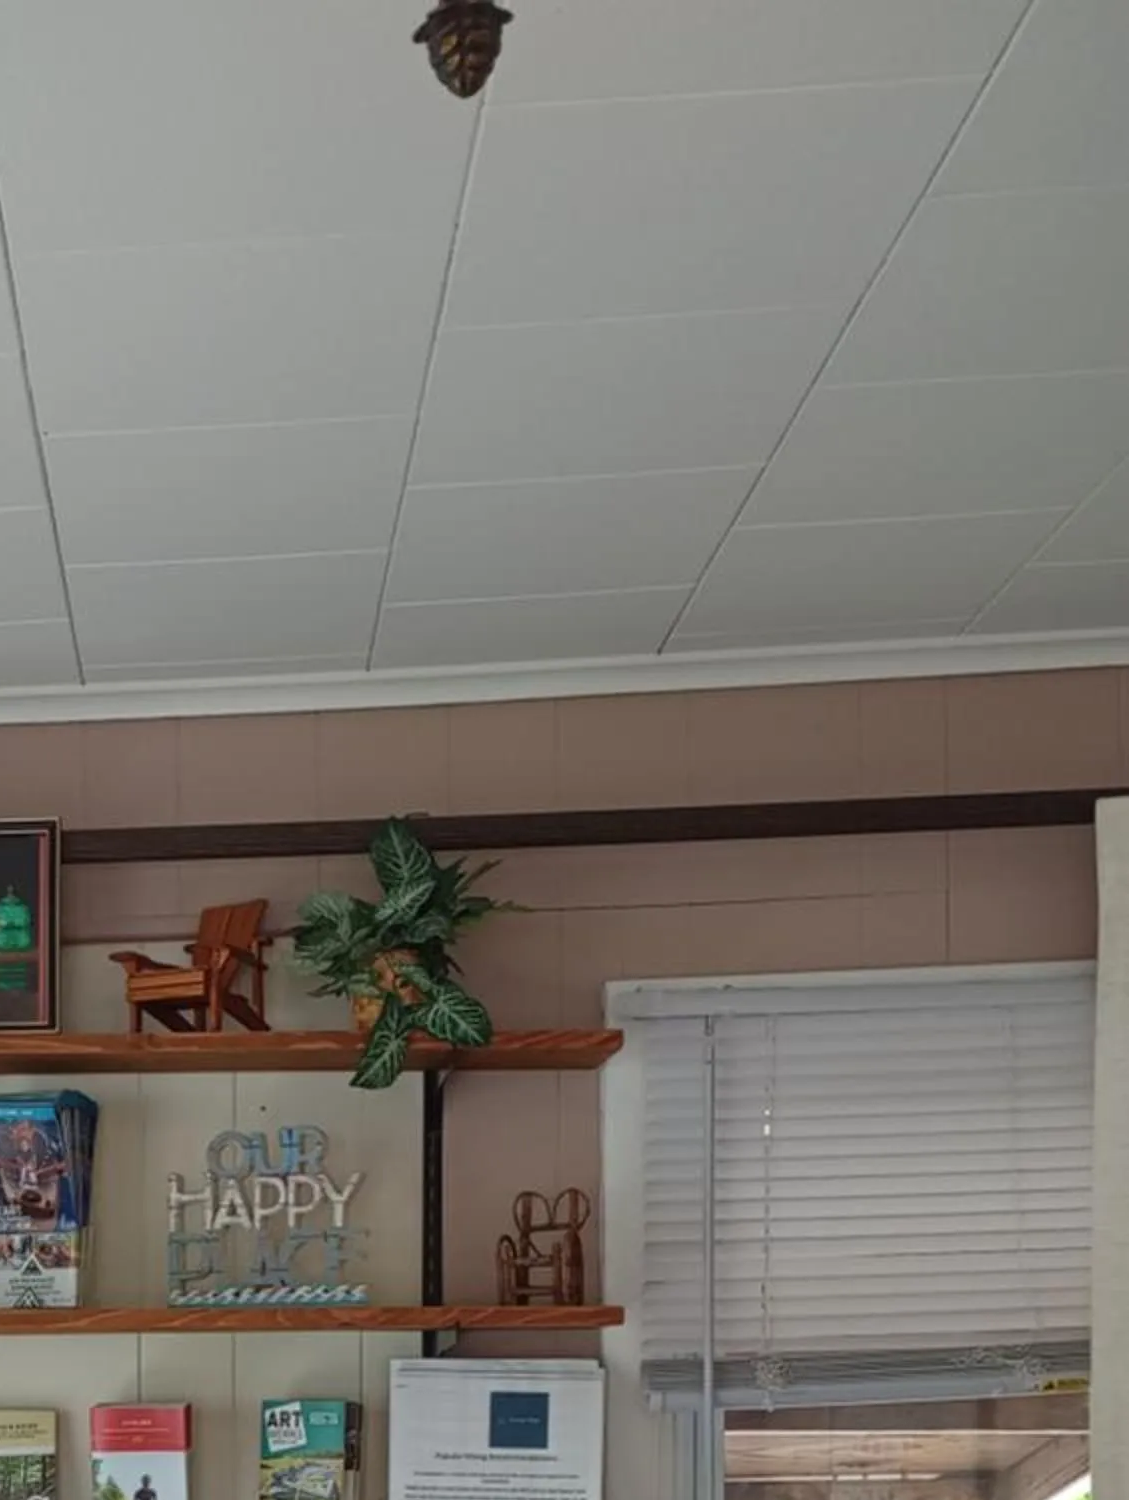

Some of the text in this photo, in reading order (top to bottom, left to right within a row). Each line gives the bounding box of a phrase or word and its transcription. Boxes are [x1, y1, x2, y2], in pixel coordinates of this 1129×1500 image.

[206, 1125, 328, 1179] OUR
[167, 1172, 363, 1231] HAPPY
[267, 1410, 301, 1428] ART
